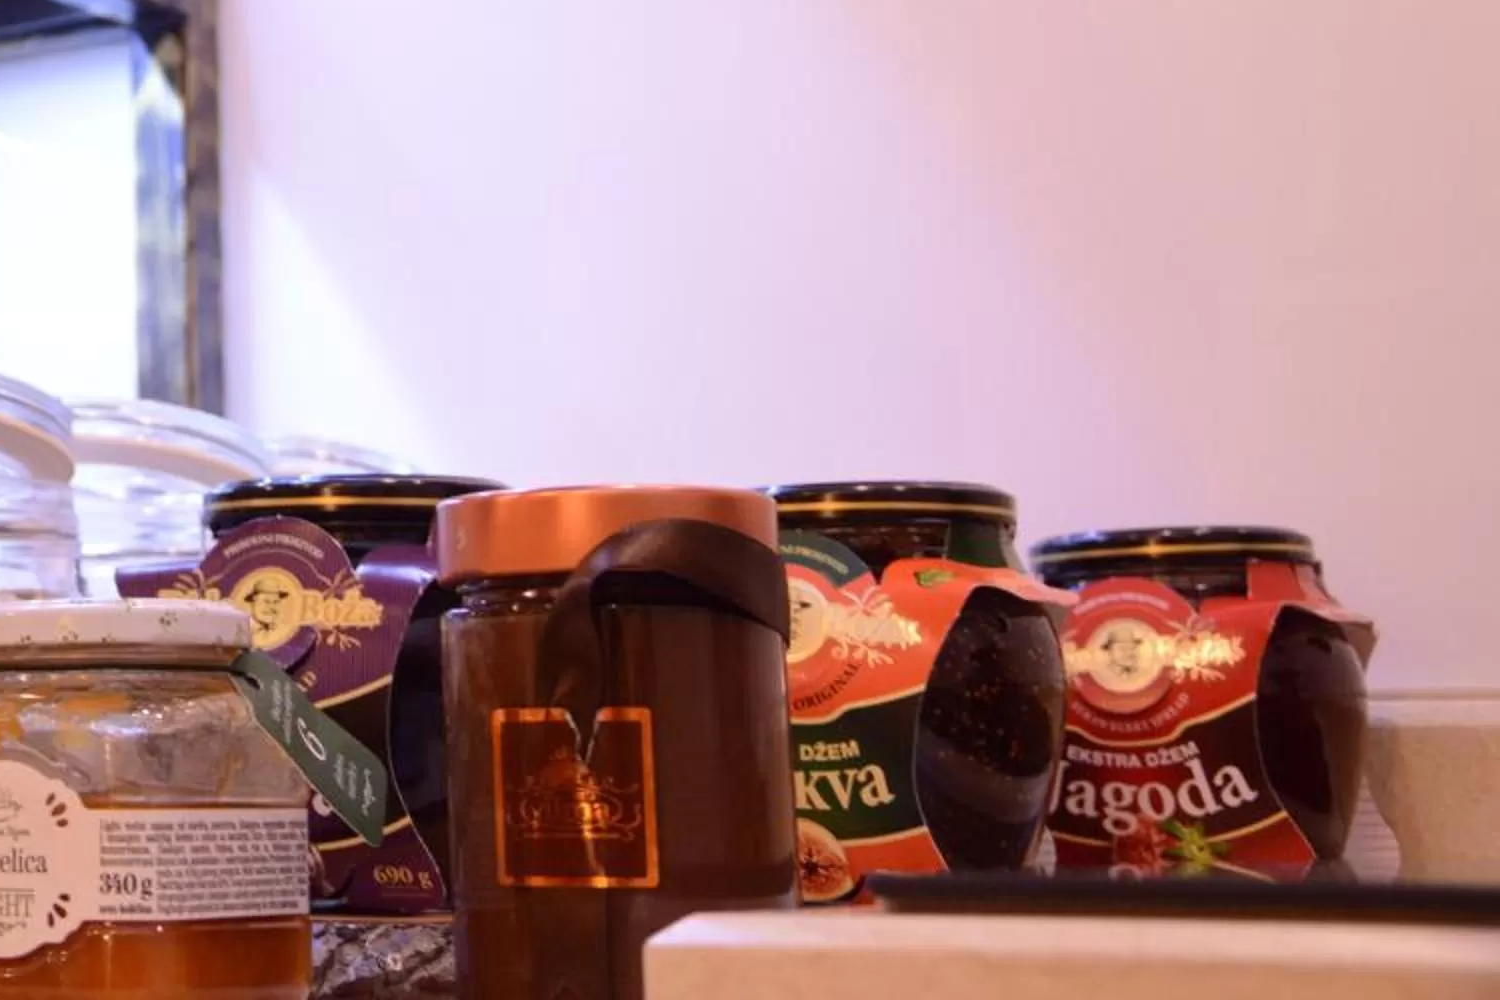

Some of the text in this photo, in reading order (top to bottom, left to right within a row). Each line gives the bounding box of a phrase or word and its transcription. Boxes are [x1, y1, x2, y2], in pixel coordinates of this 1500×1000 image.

[792, 663, 861, 711] ORIGINAL
[799, 739, 860, 762] DŽEM
[1067, 740, 1199, 769] EKSTRA DŽEM
[99, 872, 138, 896] 340
[140, 877, 153, 900] g
[373, 866, 434, 889] 690 g
